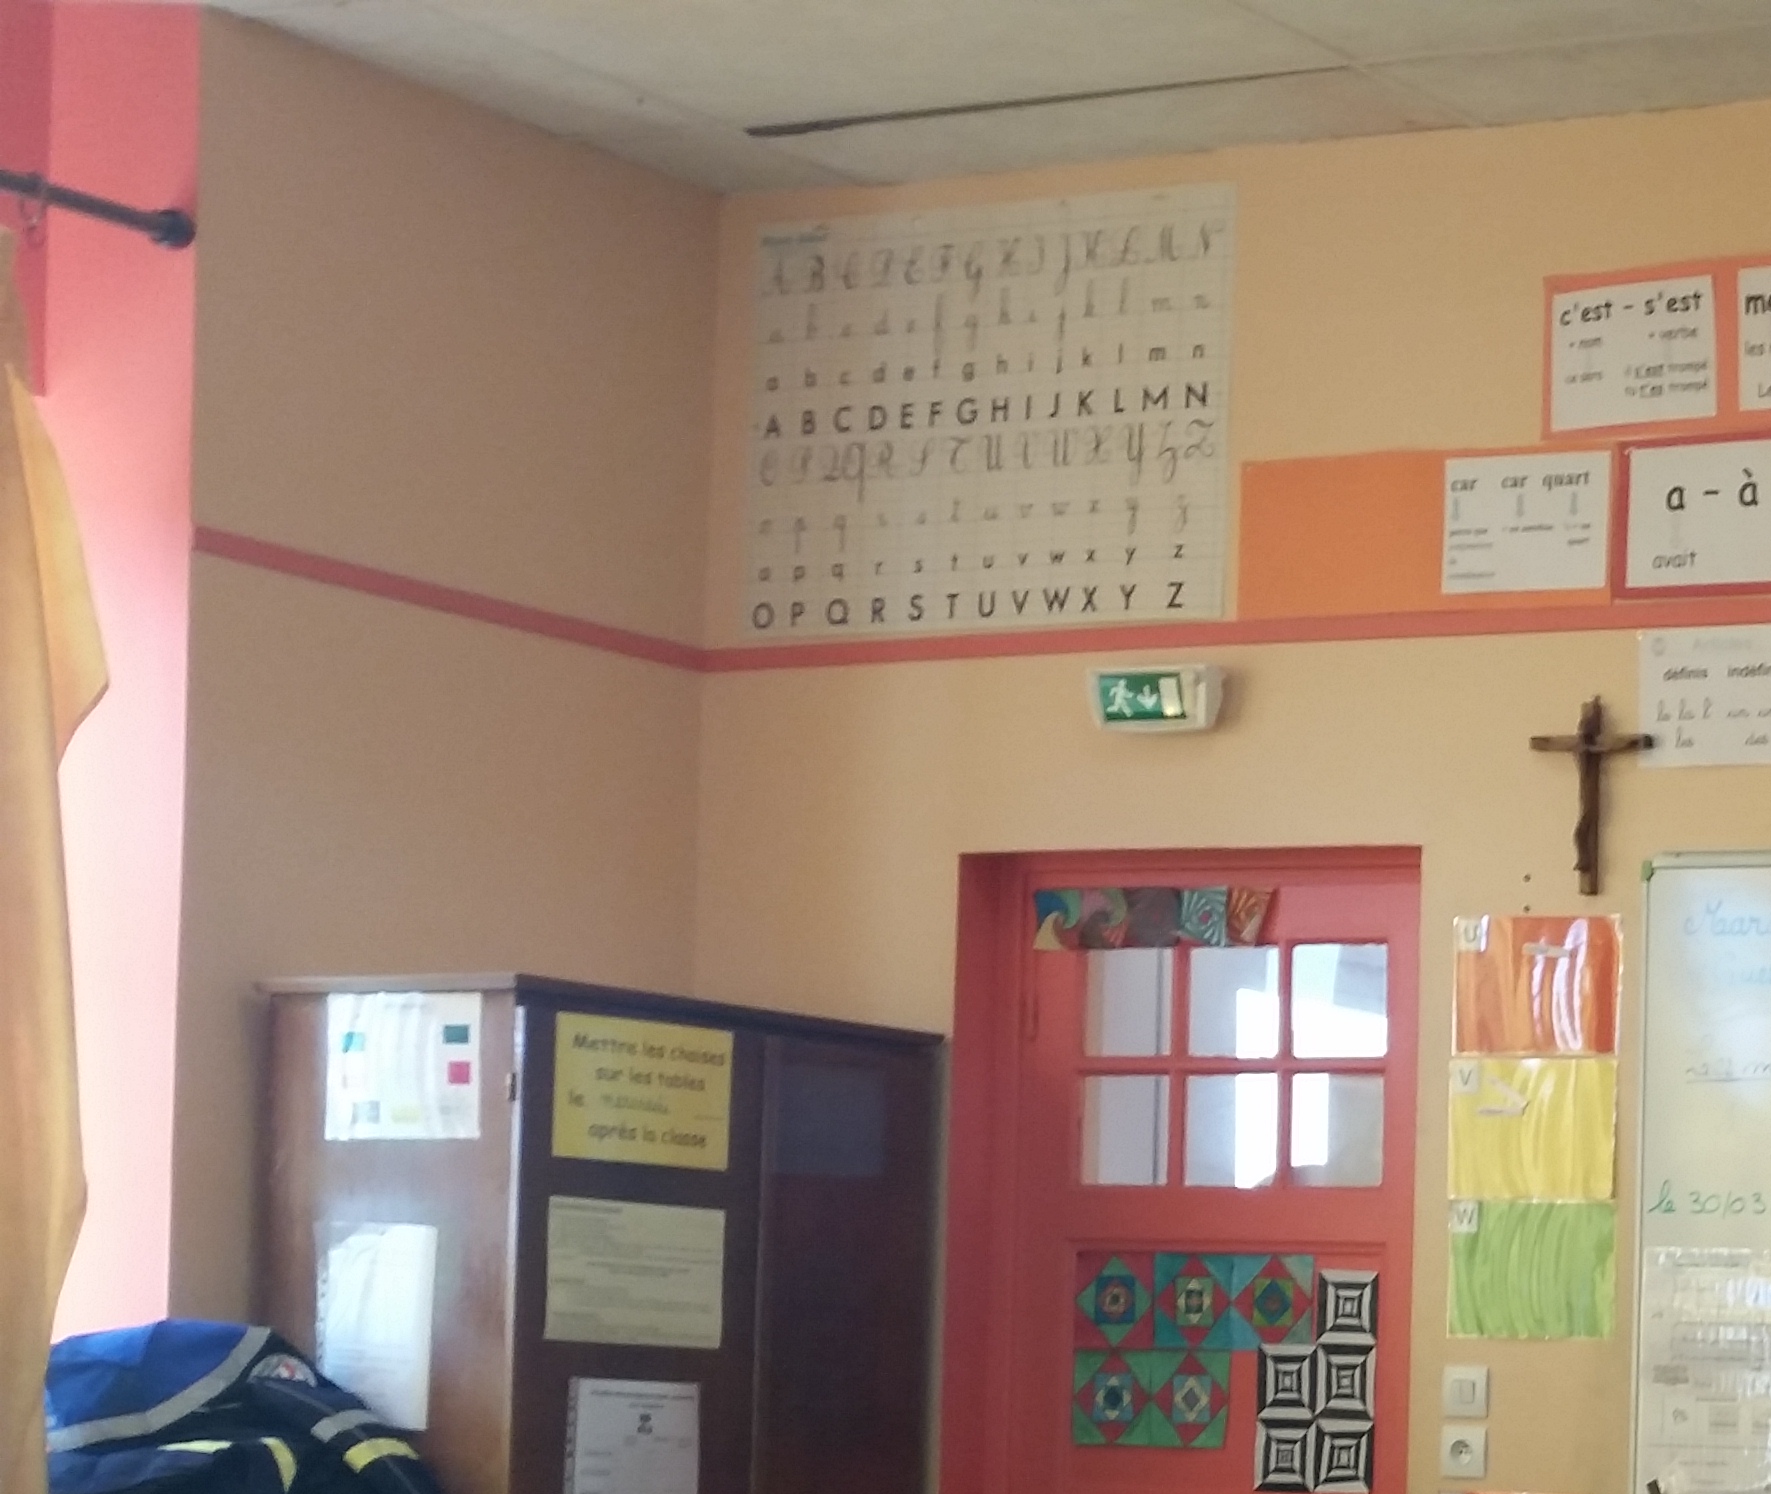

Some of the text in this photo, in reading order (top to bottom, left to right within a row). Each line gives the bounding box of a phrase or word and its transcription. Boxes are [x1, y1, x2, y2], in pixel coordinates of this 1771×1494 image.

[1559, 291, 1703, 326] c'est s'est
[1451, 477, 1478, 492] car
[1667, 469, 1758, 511] a à
[1652, 550, 1697, 569] avait
[1459, 1068, 1472, 1086] V
[1455, 1207, 1475, 1226] W
